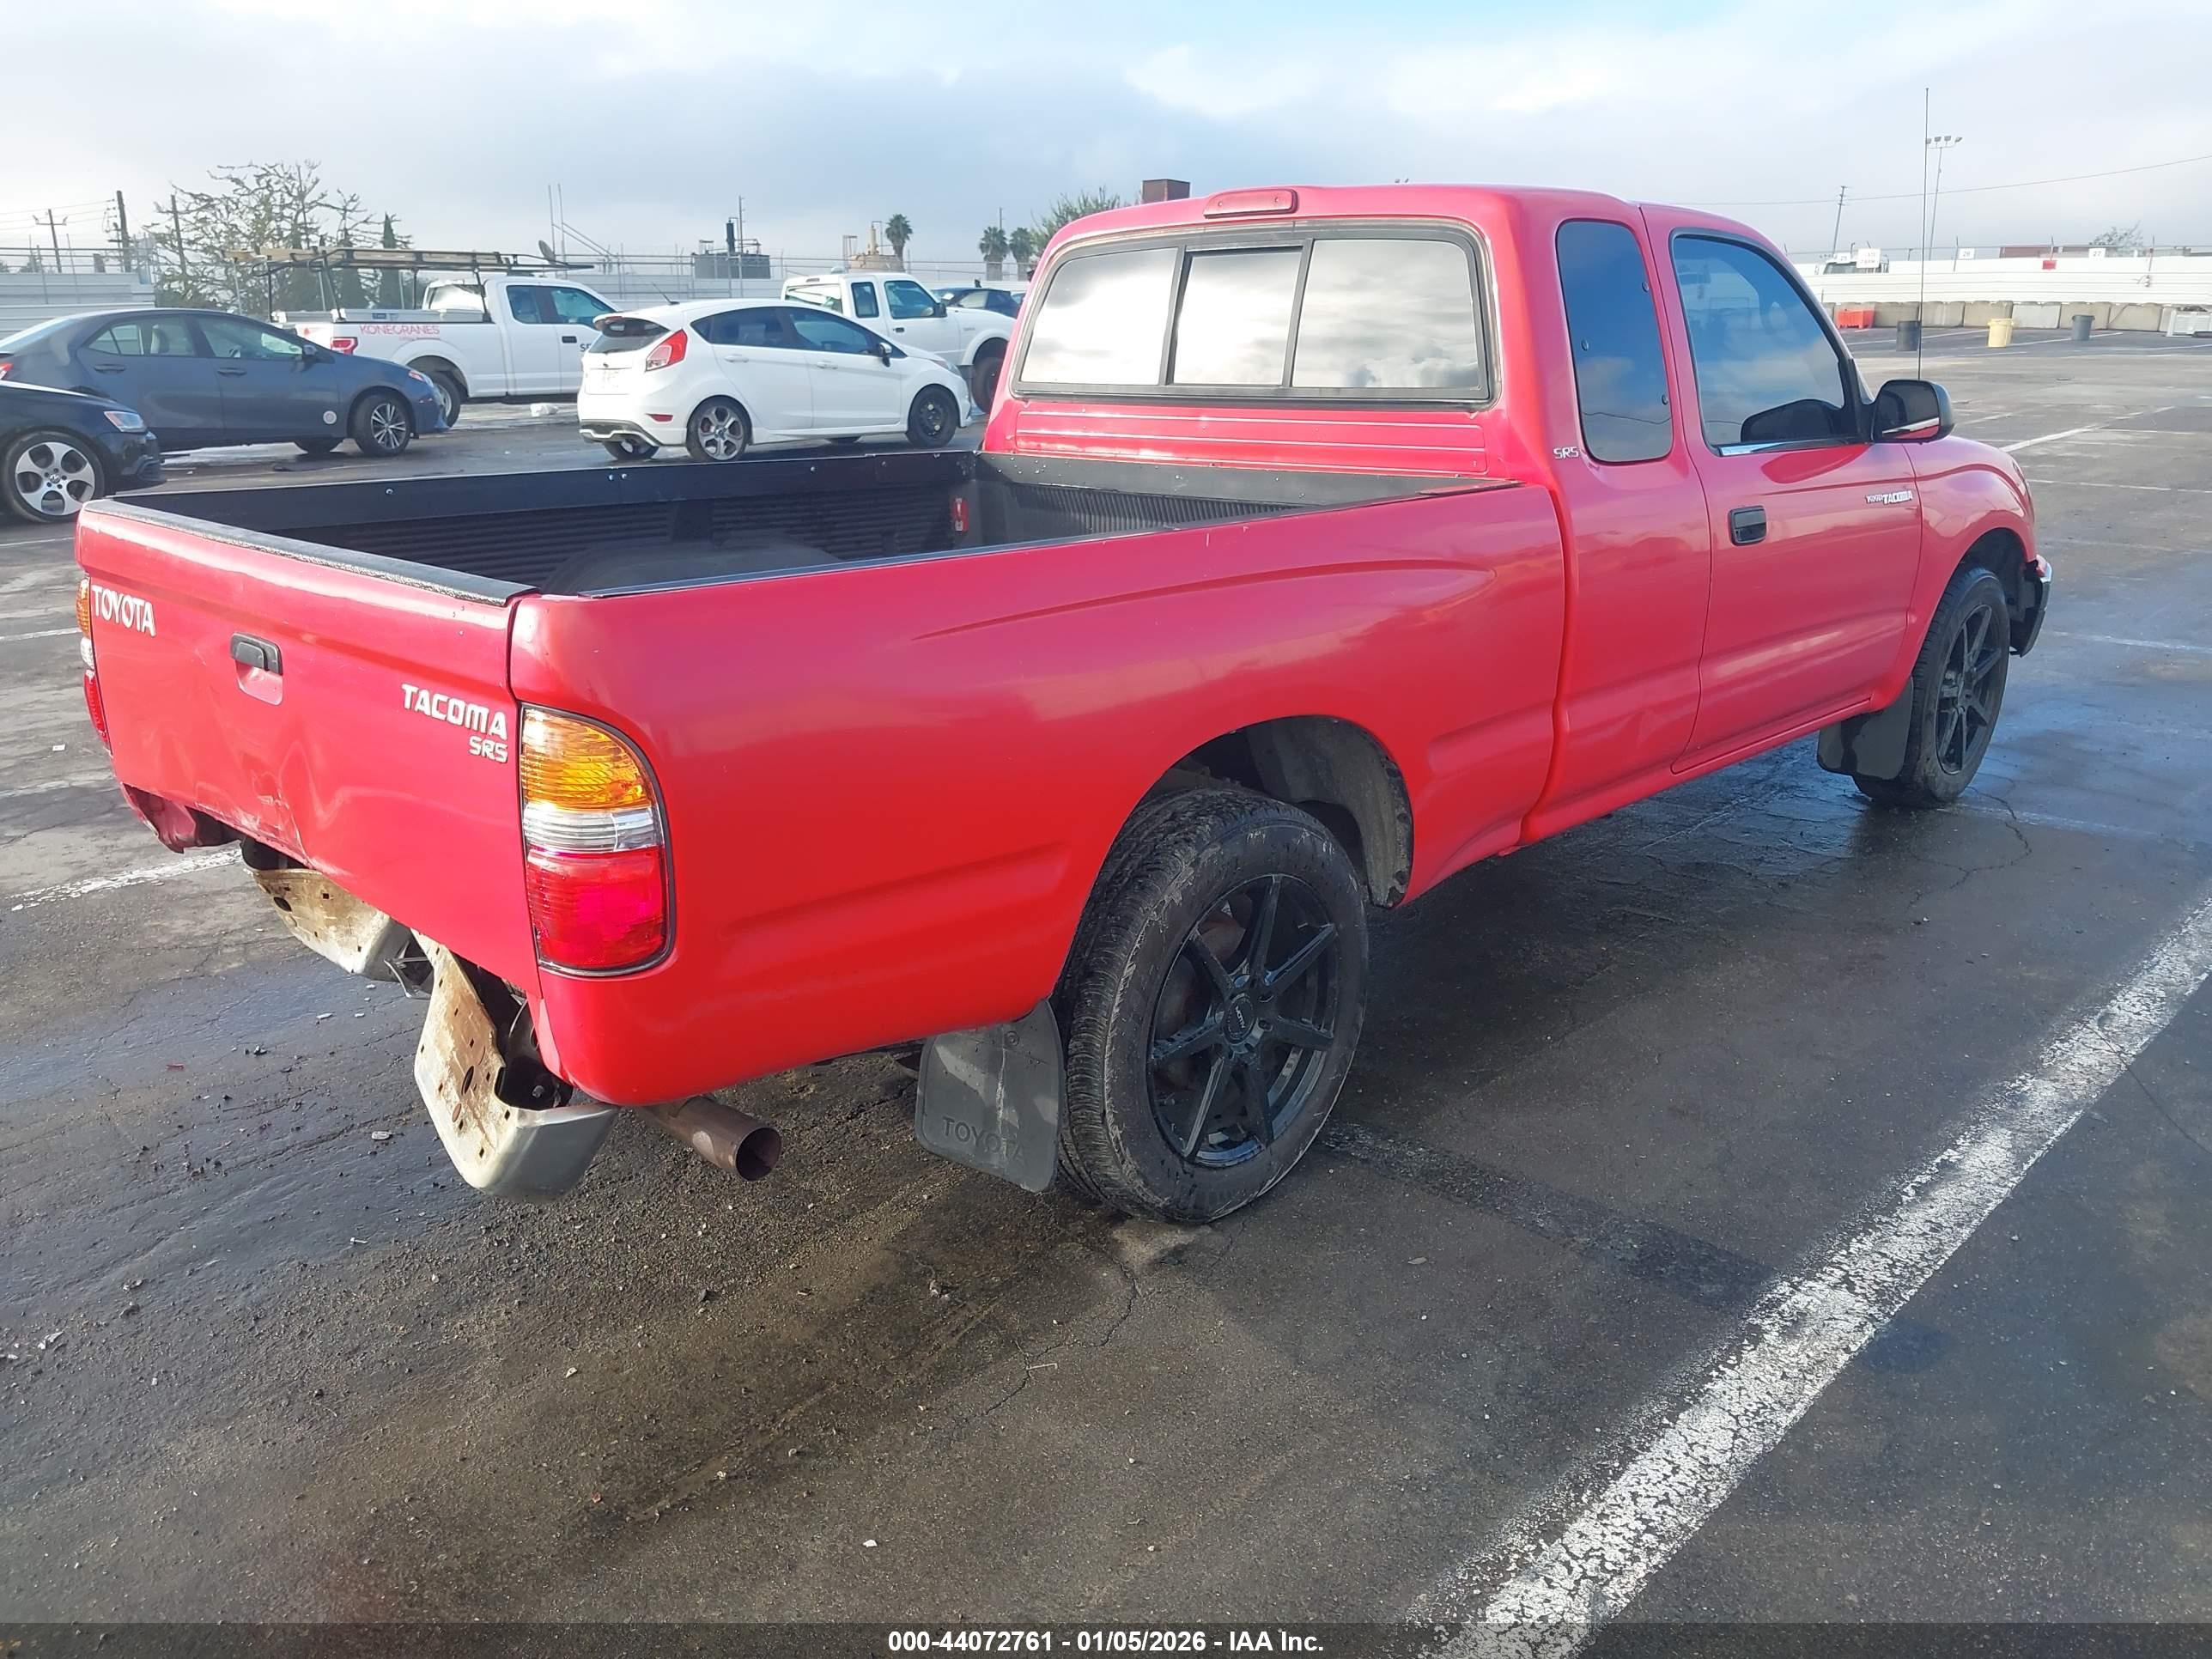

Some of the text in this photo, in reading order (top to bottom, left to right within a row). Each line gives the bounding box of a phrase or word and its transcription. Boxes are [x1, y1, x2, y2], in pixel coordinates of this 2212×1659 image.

[360, 324, 440, 335] KONECRANES
[1553, 447, 1579, 459] SRS
[91, 584, 156, 637] TOYOTA
[401, 683, 507, 741] TACOMA
[468, 735, 508, 763] SRS
